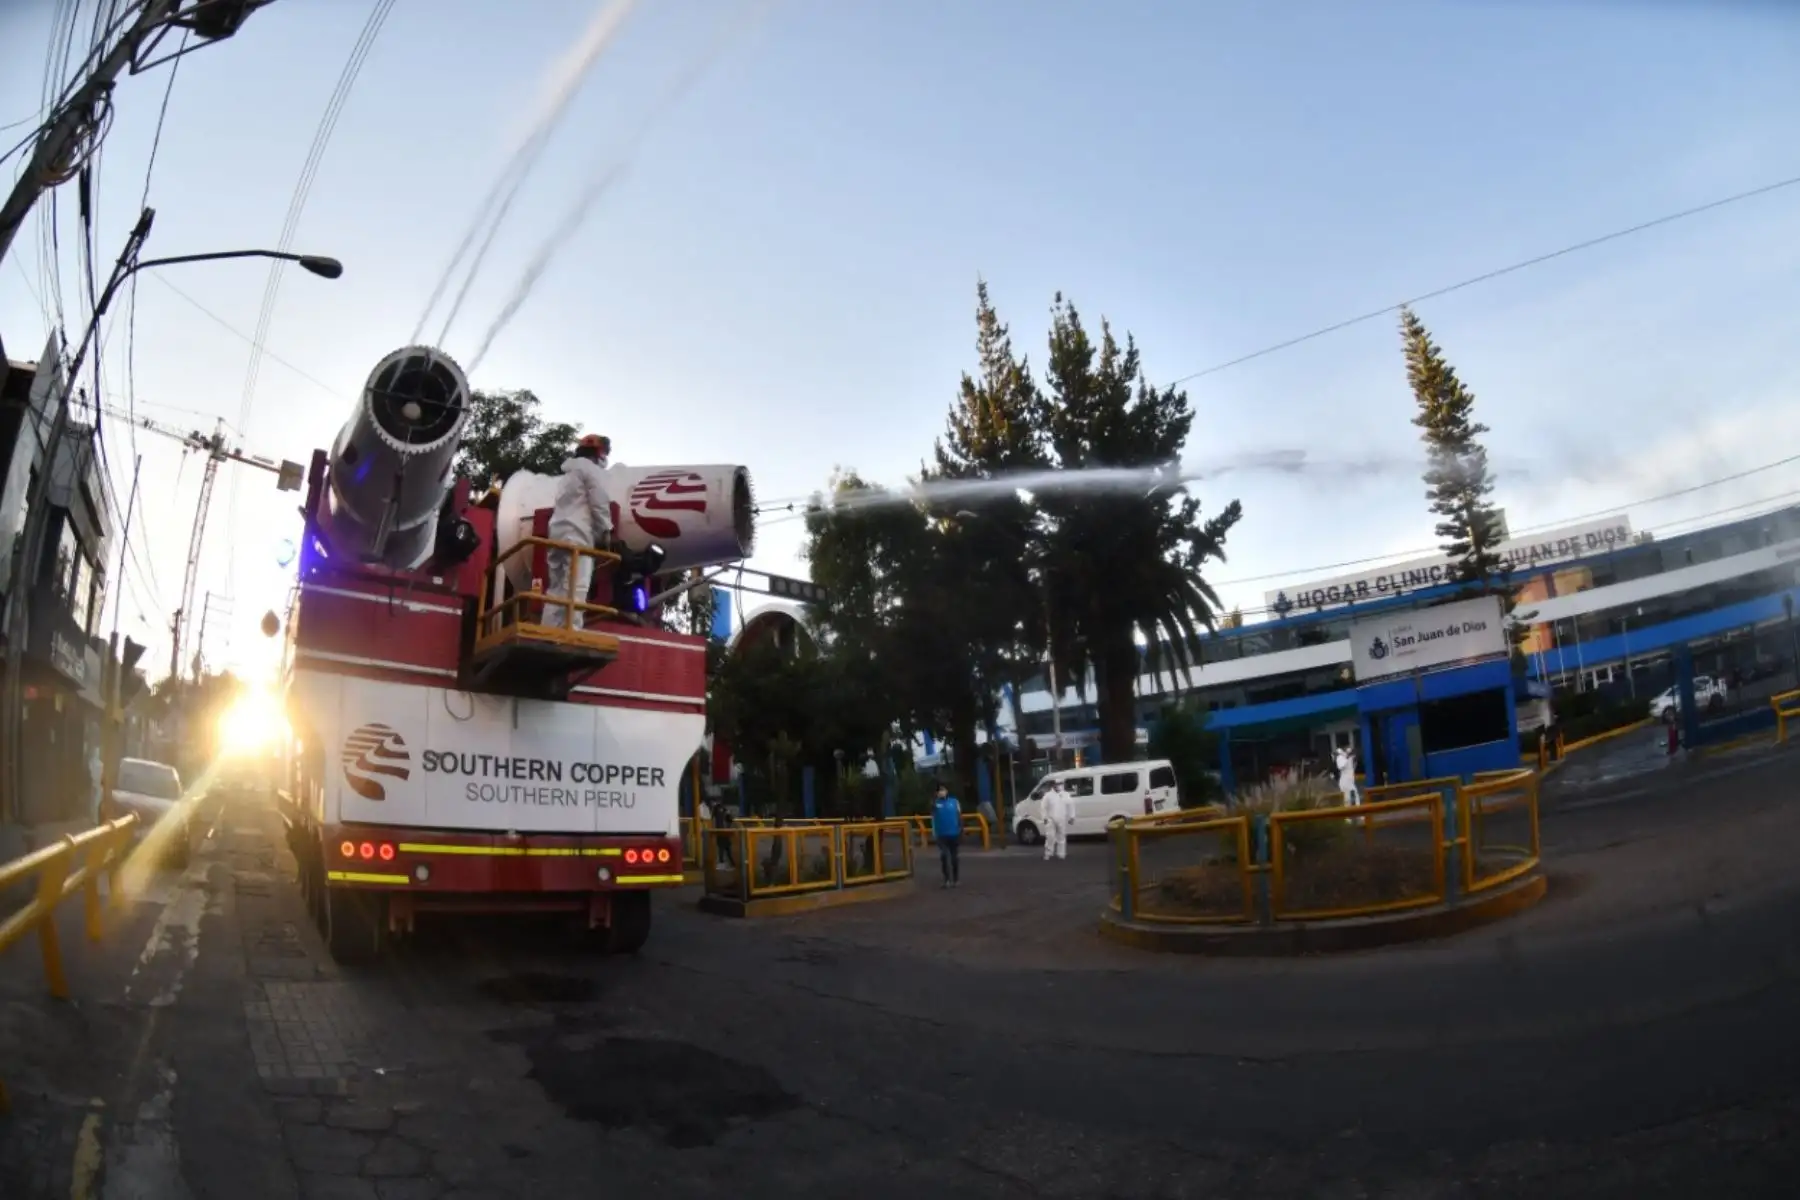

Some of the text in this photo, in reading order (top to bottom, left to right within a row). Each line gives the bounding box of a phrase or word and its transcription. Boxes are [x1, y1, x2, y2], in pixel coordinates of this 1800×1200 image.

[1297, 525, 1628, 608] HOGAR CLINICA JUAN DE DIOS
[1393, 635, 1416, 649] San
[1417, 628, 1445, 643] Juan
[1446, 624, 1461, 637] de
[1462, 621, 1487, 634] Dios
[422, 750, 666, 787] SOUTHERN COPPER
[465, 782, 637, 809] SOUTHERN PERU
